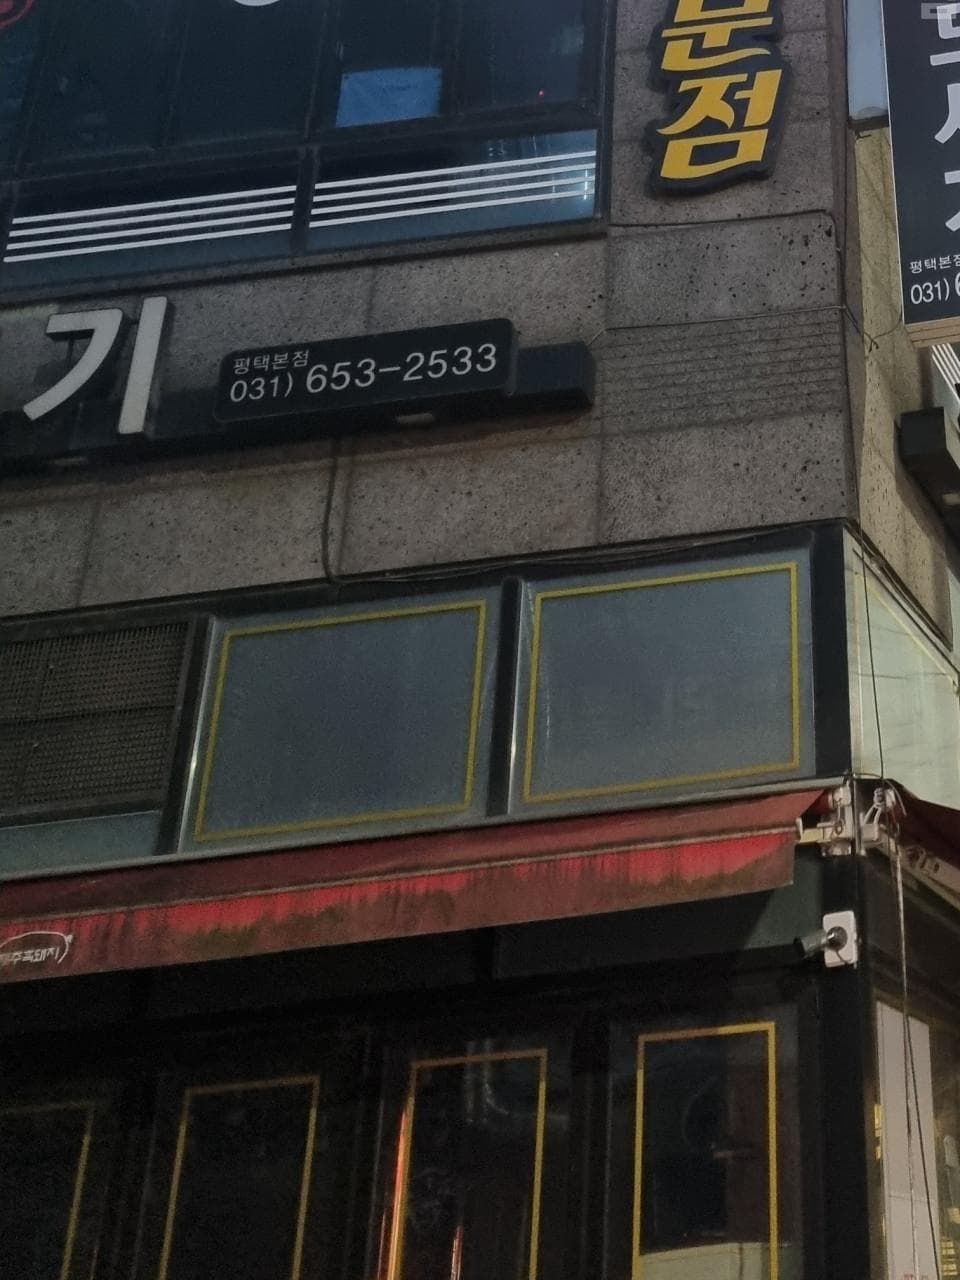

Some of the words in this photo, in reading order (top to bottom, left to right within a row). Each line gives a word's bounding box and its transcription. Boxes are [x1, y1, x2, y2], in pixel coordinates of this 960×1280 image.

[910, 277, 951, 305] 031)
[22, 295, 168, 435] 기
[229, 371, 294, 404] 031)
[305, 343, 498, 394] 653-2533
[232, 349, 310, 376] 평택본점
